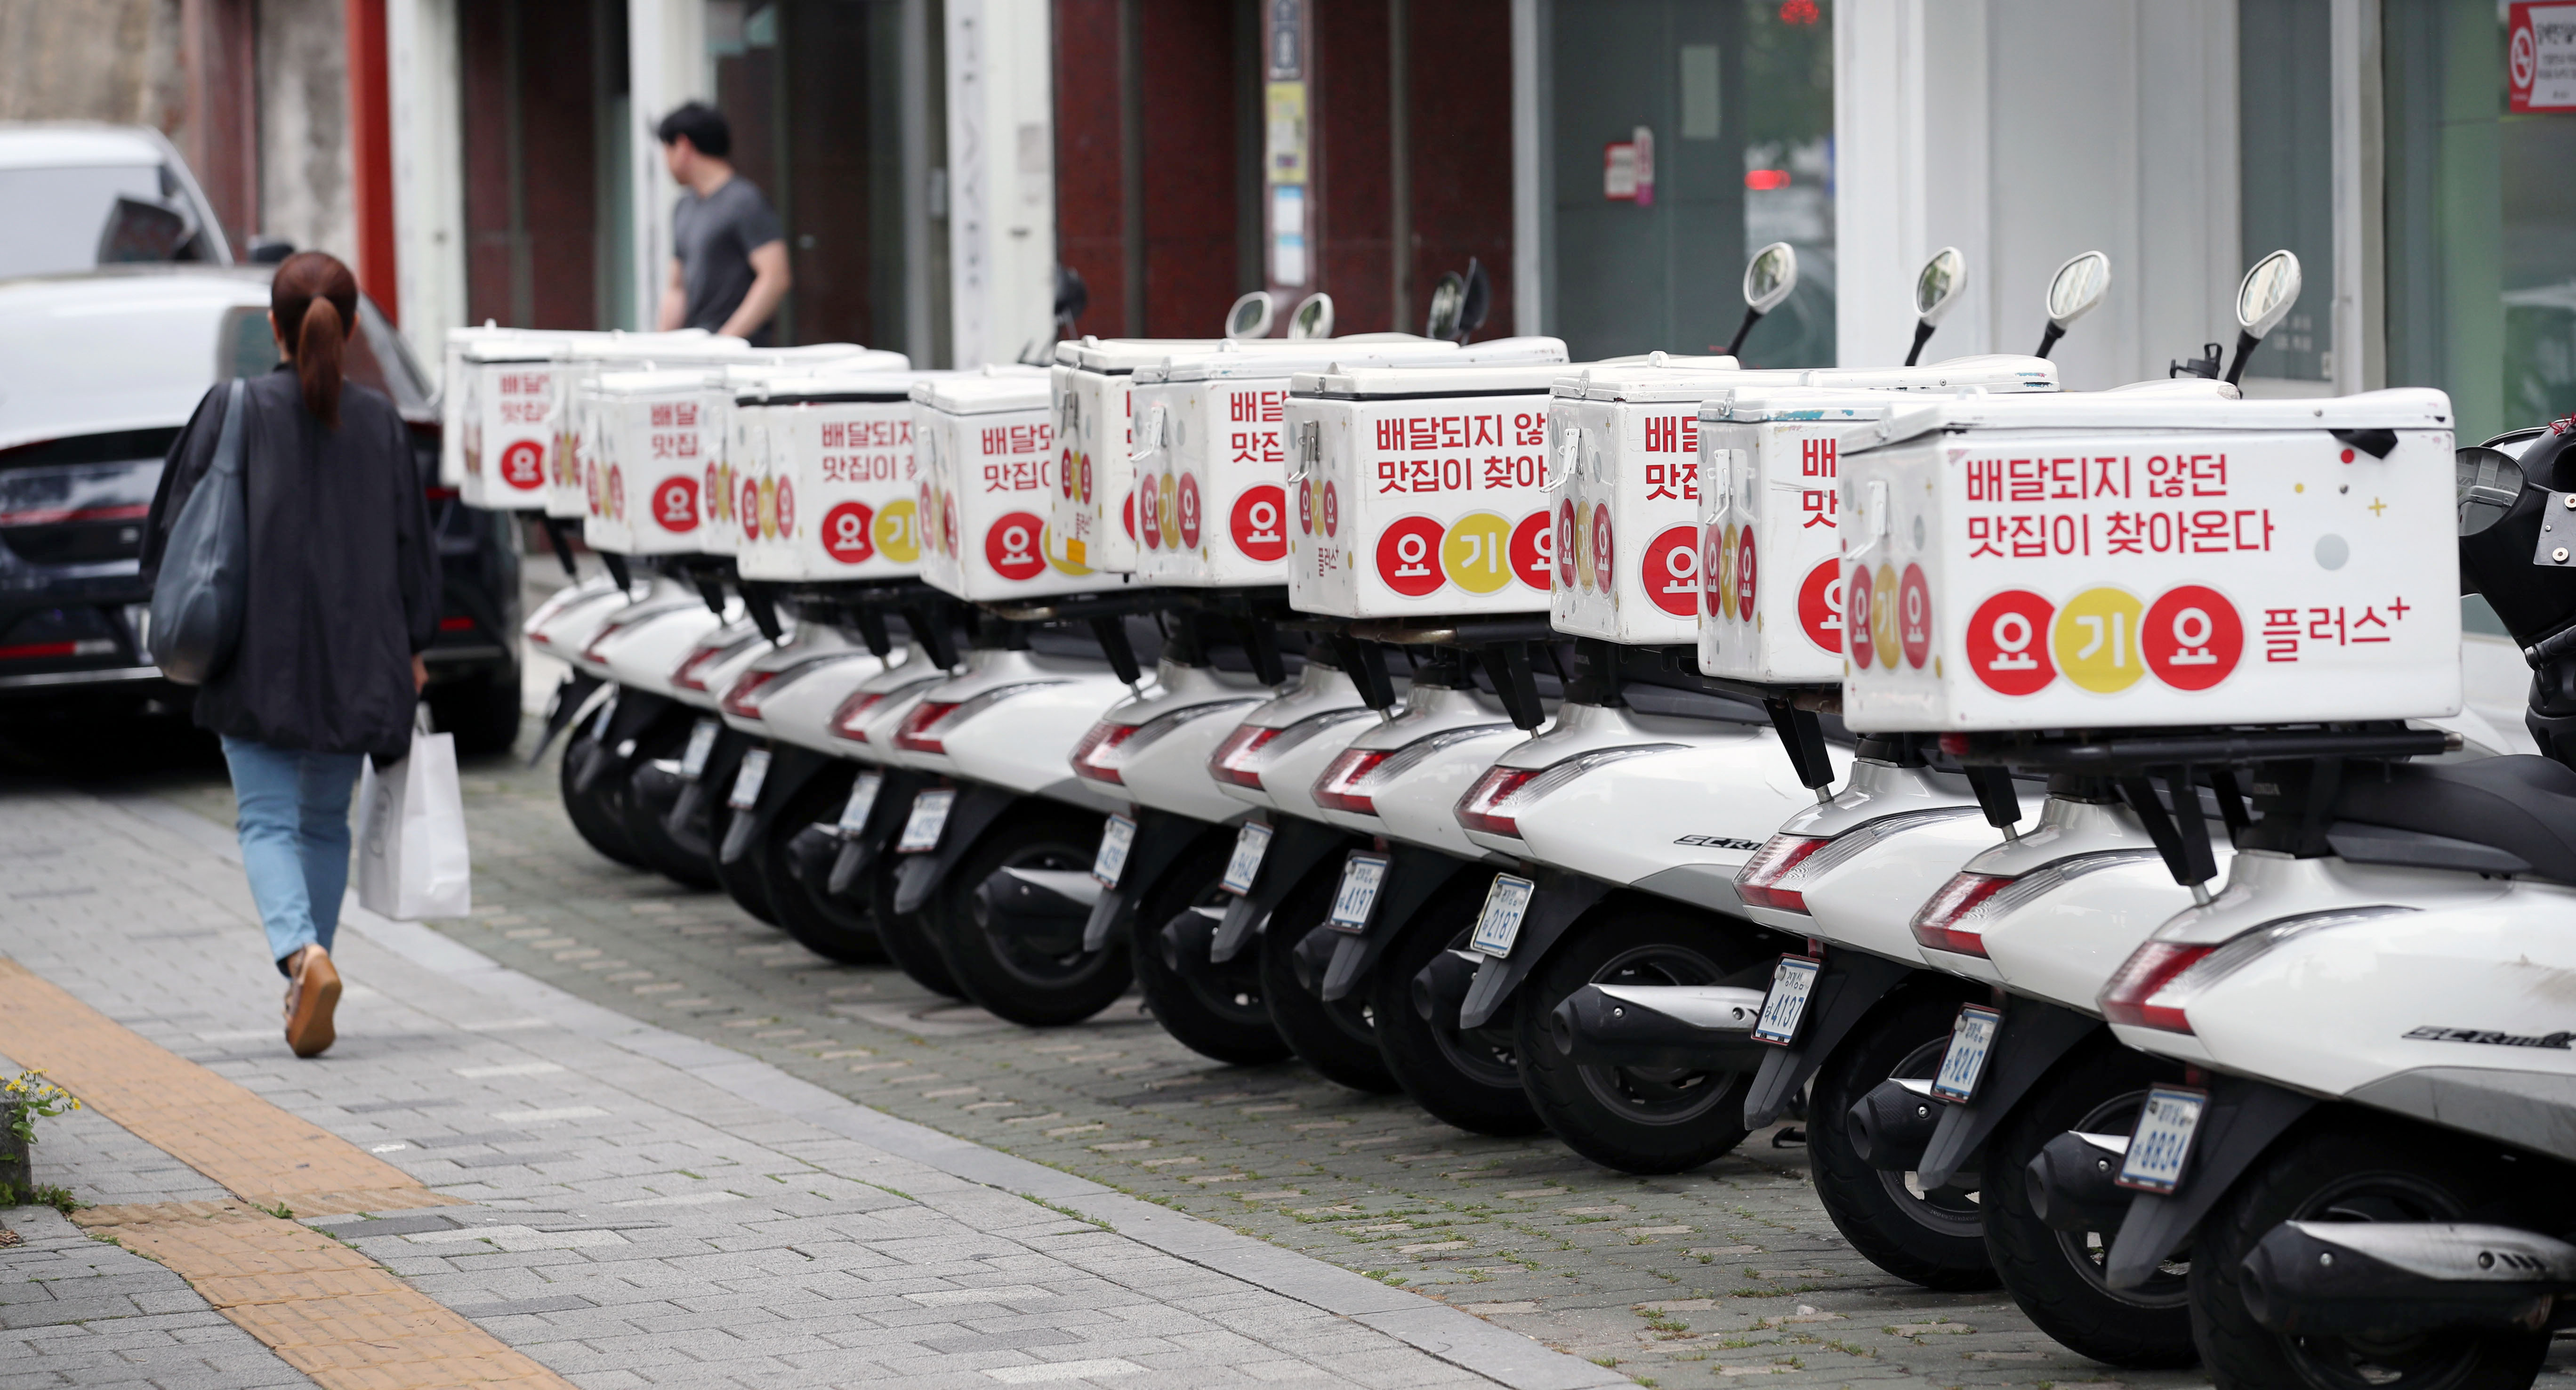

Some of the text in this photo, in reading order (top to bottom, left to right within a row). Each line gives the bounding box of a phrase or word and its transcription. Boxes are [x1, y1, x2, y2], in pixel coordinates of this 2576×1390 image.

[500, 374, 549, 395] 배달
[1377, 412, 1547, 451] 배달되지 않
[822, 455, 897, 482] 맛집이
[1378, 455, 1549, 493] 맛집이 찾아
[1967, 453, 2228, 502] 배달되지 않던
[1301, 487, 1336, 525] 요기요
[1969, 509, 2275, 559] 맛집이 찾아온다
[1985, 604, 2221, 675] 요기요
